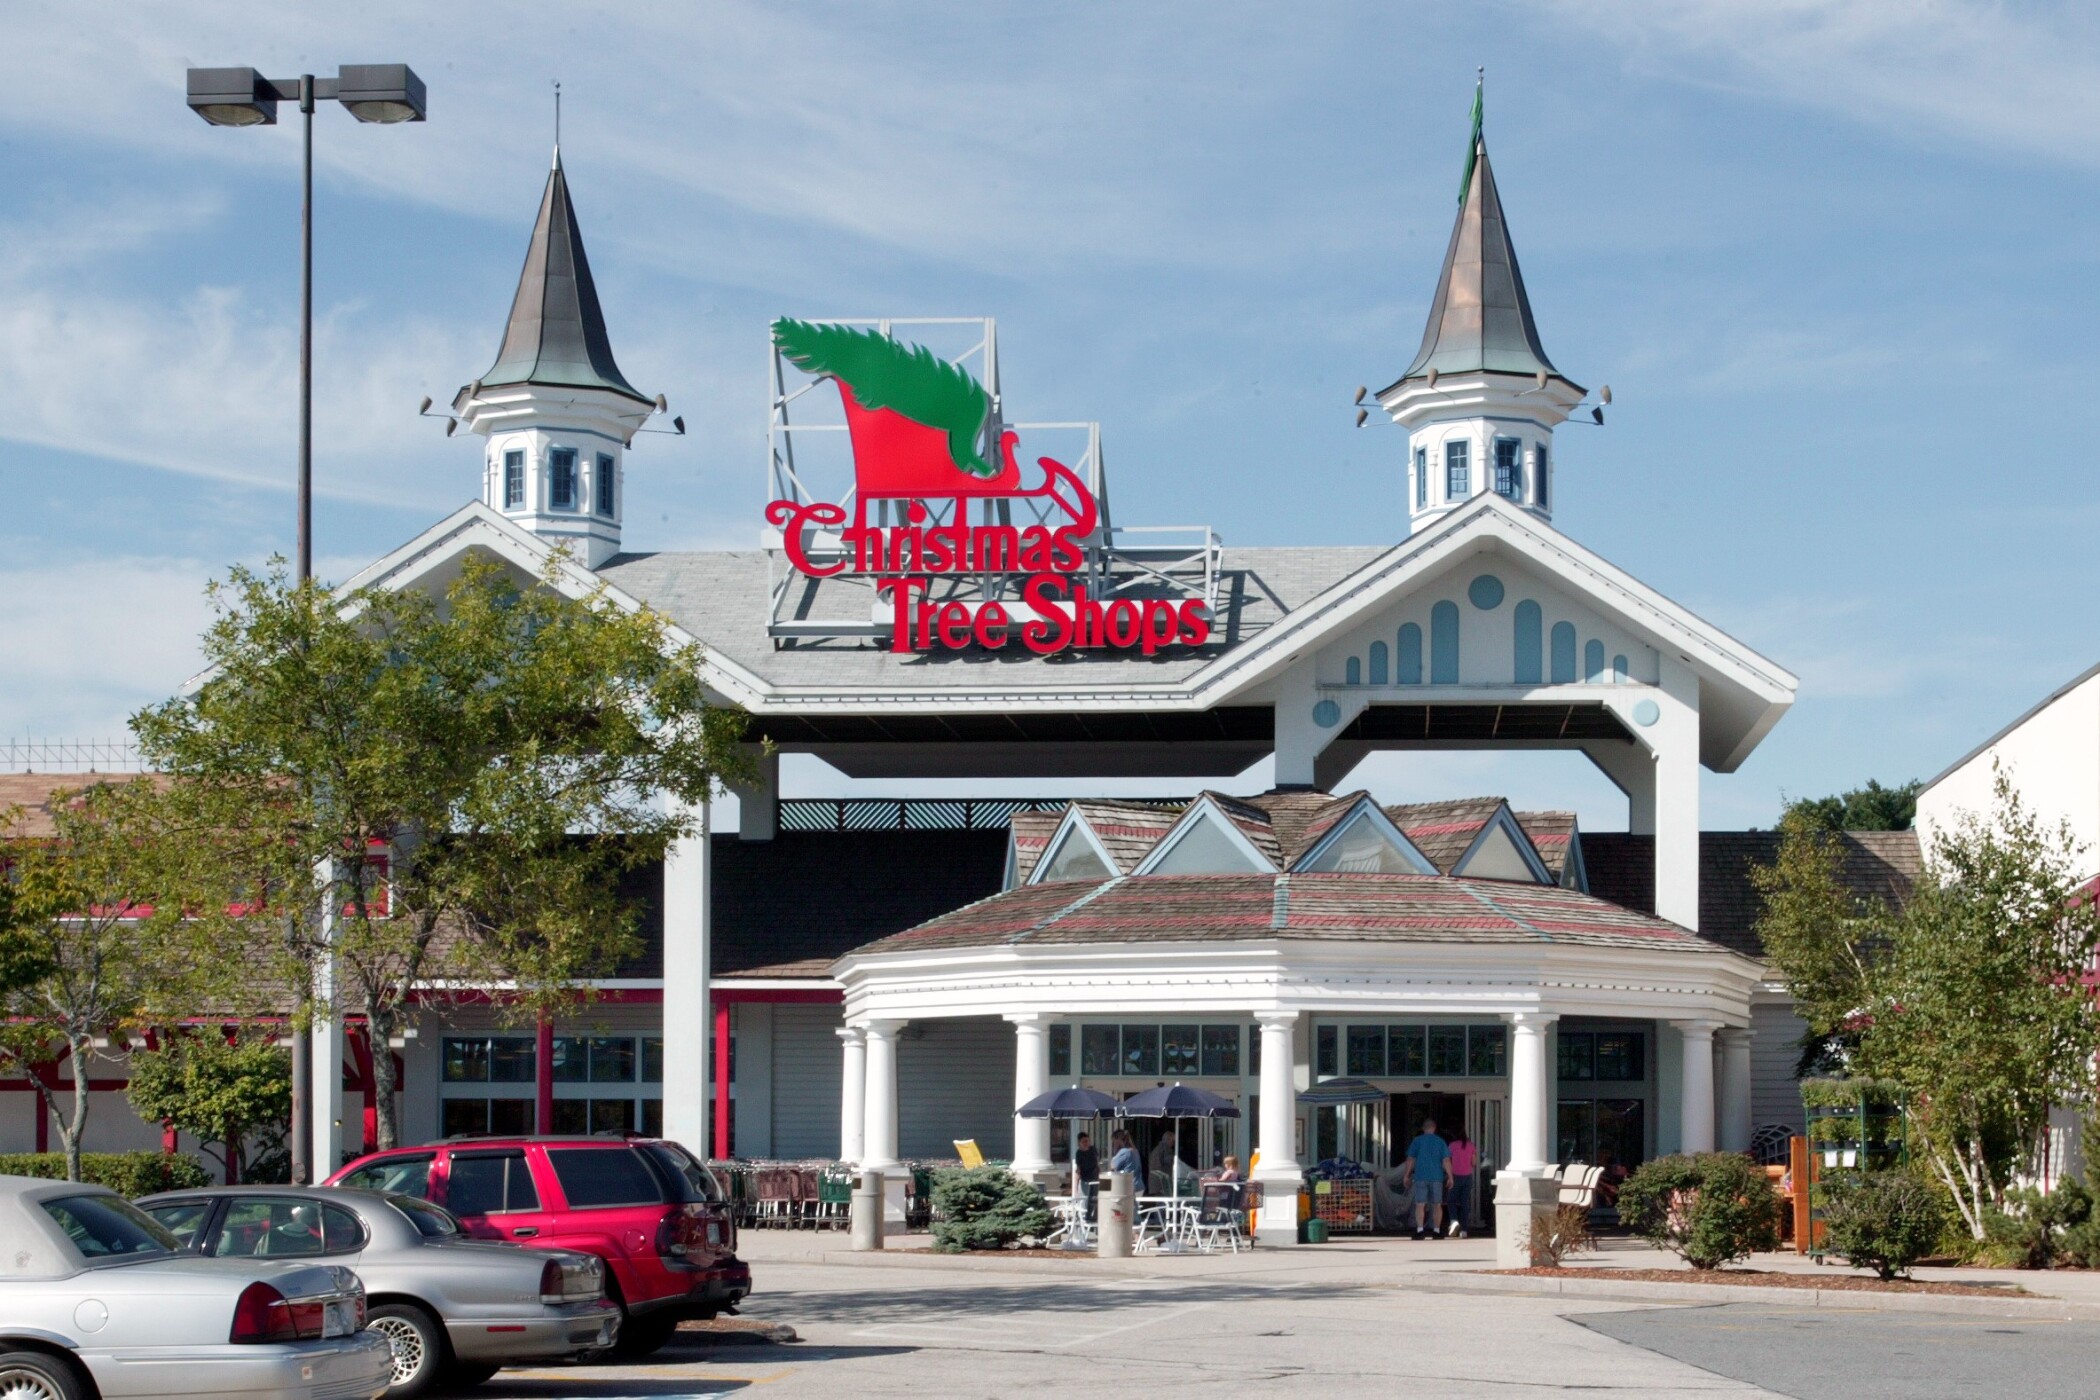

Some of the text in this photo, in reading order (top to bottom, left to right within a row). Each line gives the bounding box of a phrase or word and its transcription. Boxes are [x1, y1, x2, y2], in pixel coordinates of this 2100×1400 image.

[765, 498, 1086, 578] Christmas
[877, 572, 1210, 656] Tree Shops
